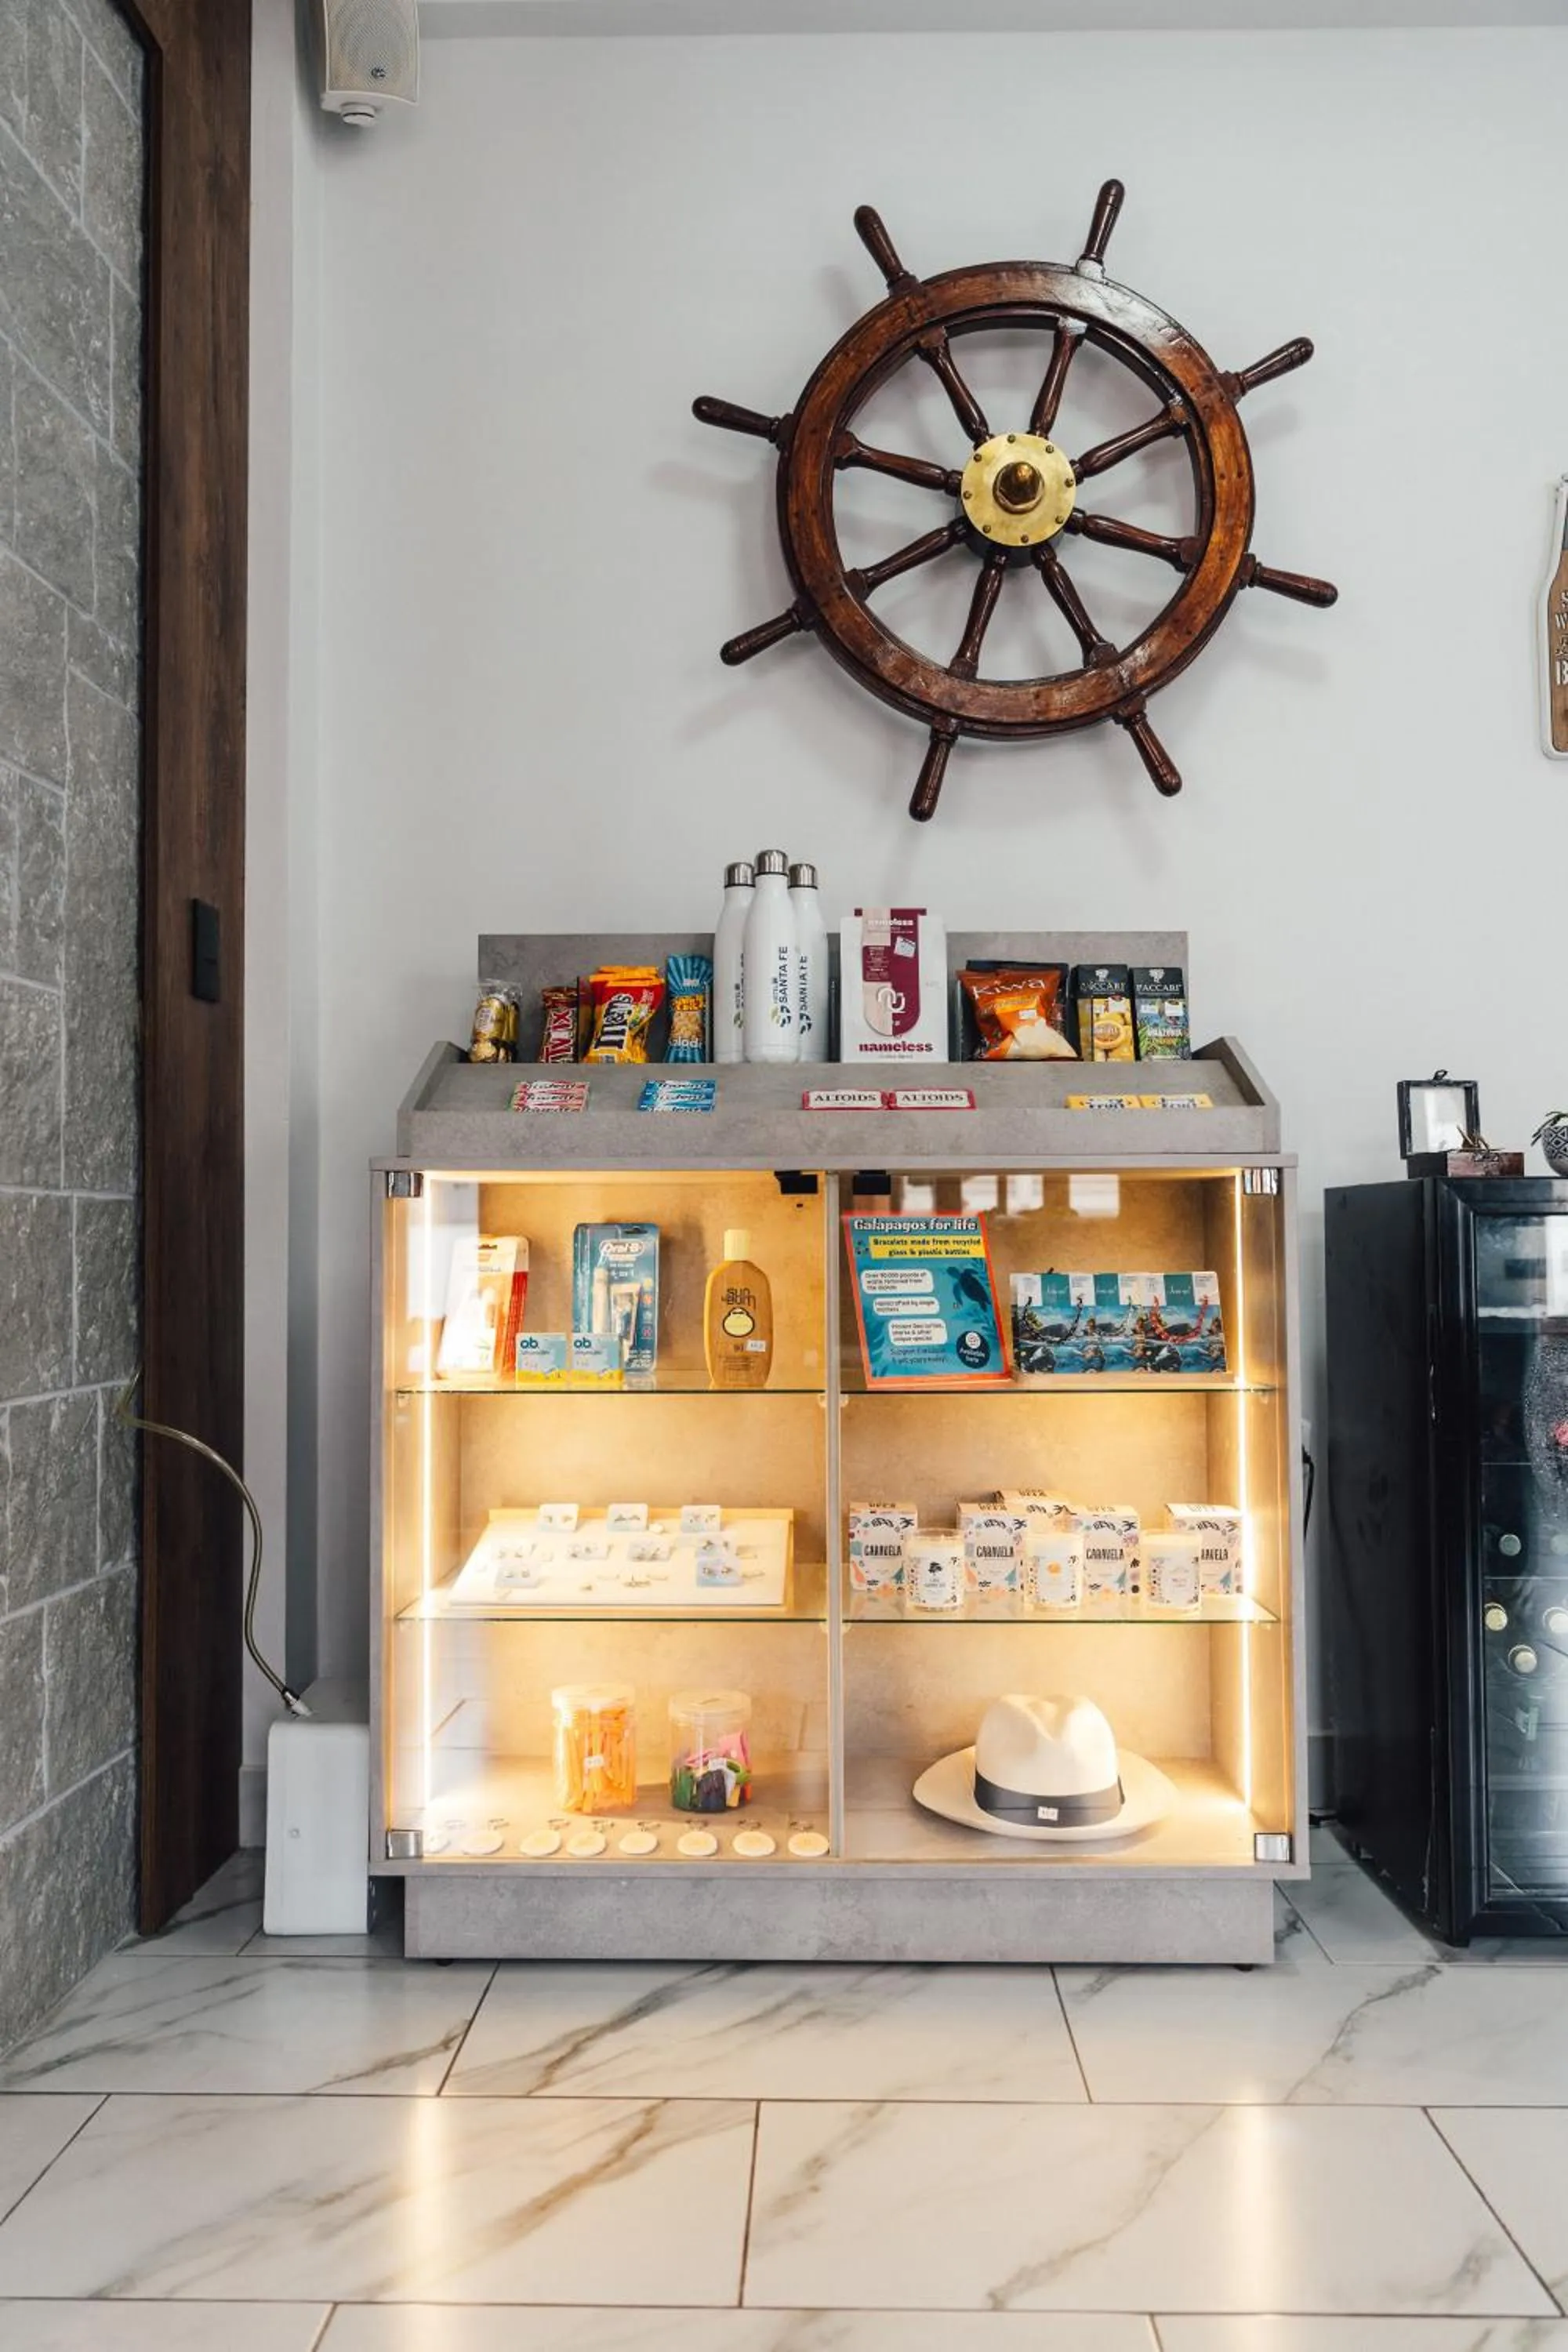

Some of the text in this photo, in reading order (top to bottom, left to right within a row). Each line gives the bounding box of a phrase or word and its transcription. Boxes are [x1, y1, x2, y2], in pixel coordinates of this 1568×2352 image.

[779, 946, 788, 1004] SANTA FE
[973, 979, 1045, 1000] Kiwa
[858, 1040, 933, 1052] nameless
[854, 1218, 976, 1232] Galapagos for life
[953, 1238, 981, 1247] recycled
[976, 1546, 1014, 1558] CARAVELA
[1086, 1548, 1125, 1559] CARAVELA
